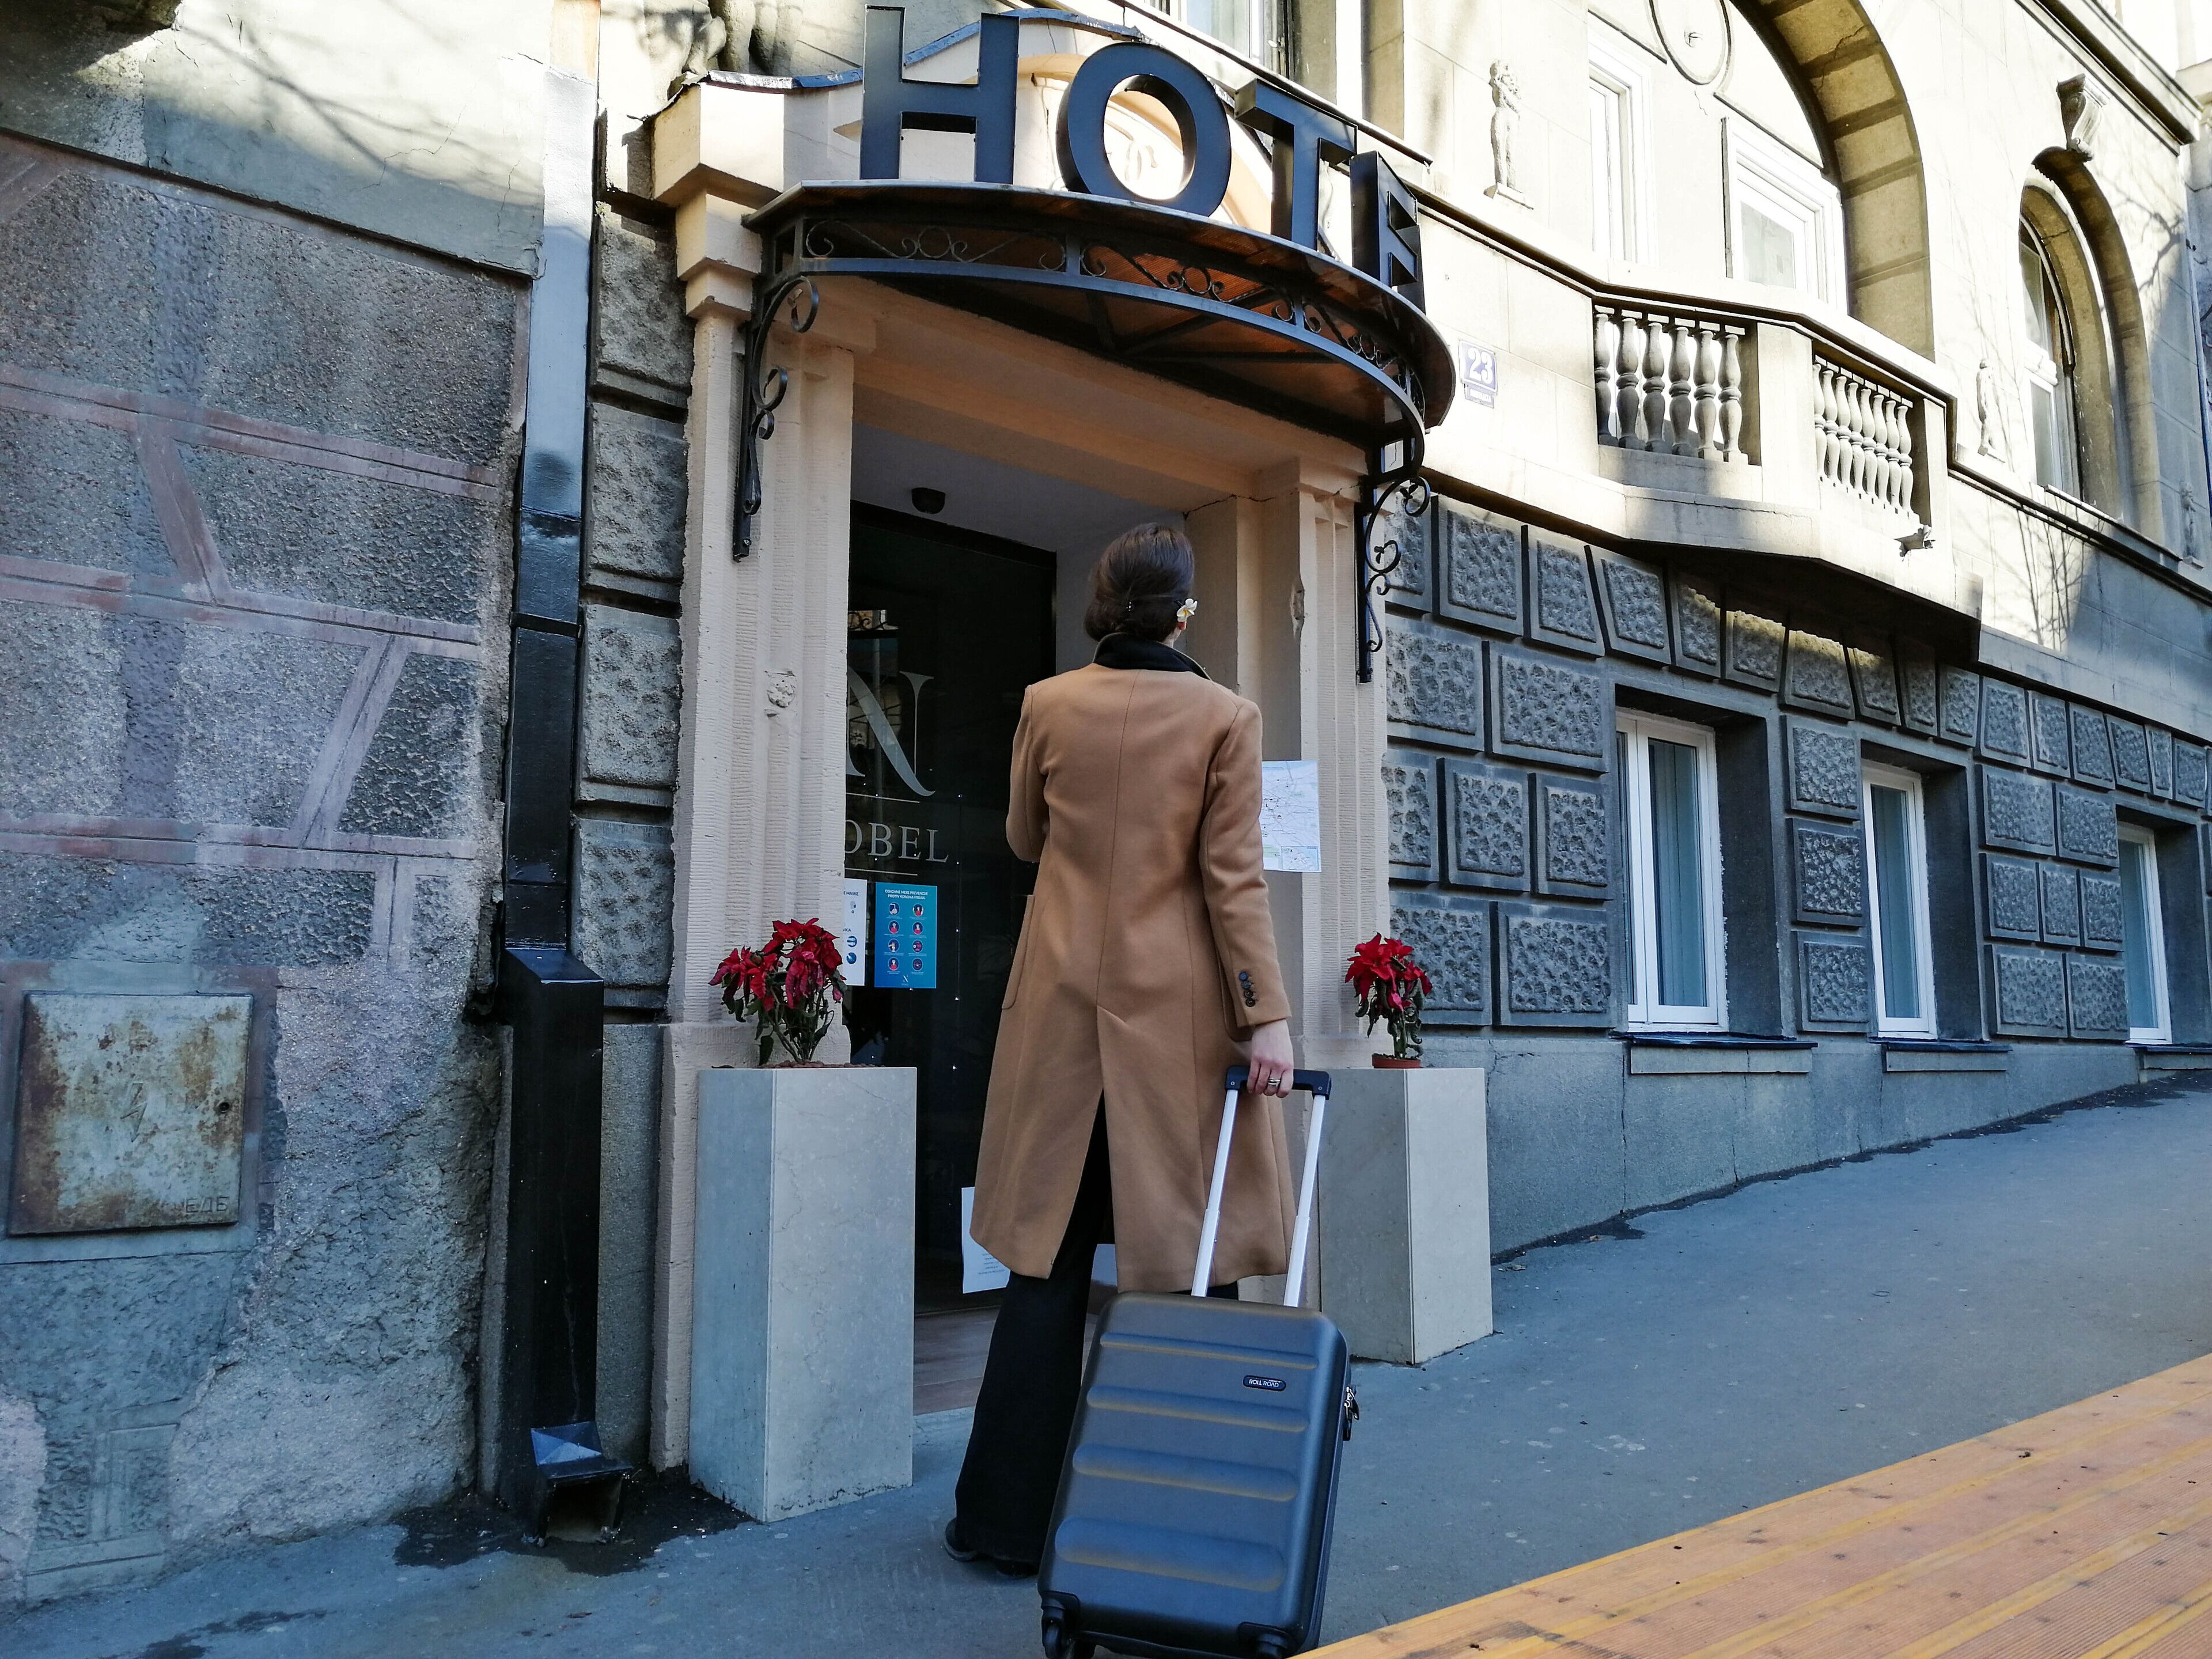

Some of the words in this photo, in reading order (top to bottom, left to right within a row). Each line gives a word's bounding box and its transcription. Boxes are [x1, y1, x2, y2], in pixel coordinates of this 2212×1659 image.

[859, 5, 1427, 316] HOTE
[1467, 347, 1493, 384] 23
[844, 819, 949, 863] OBEL
